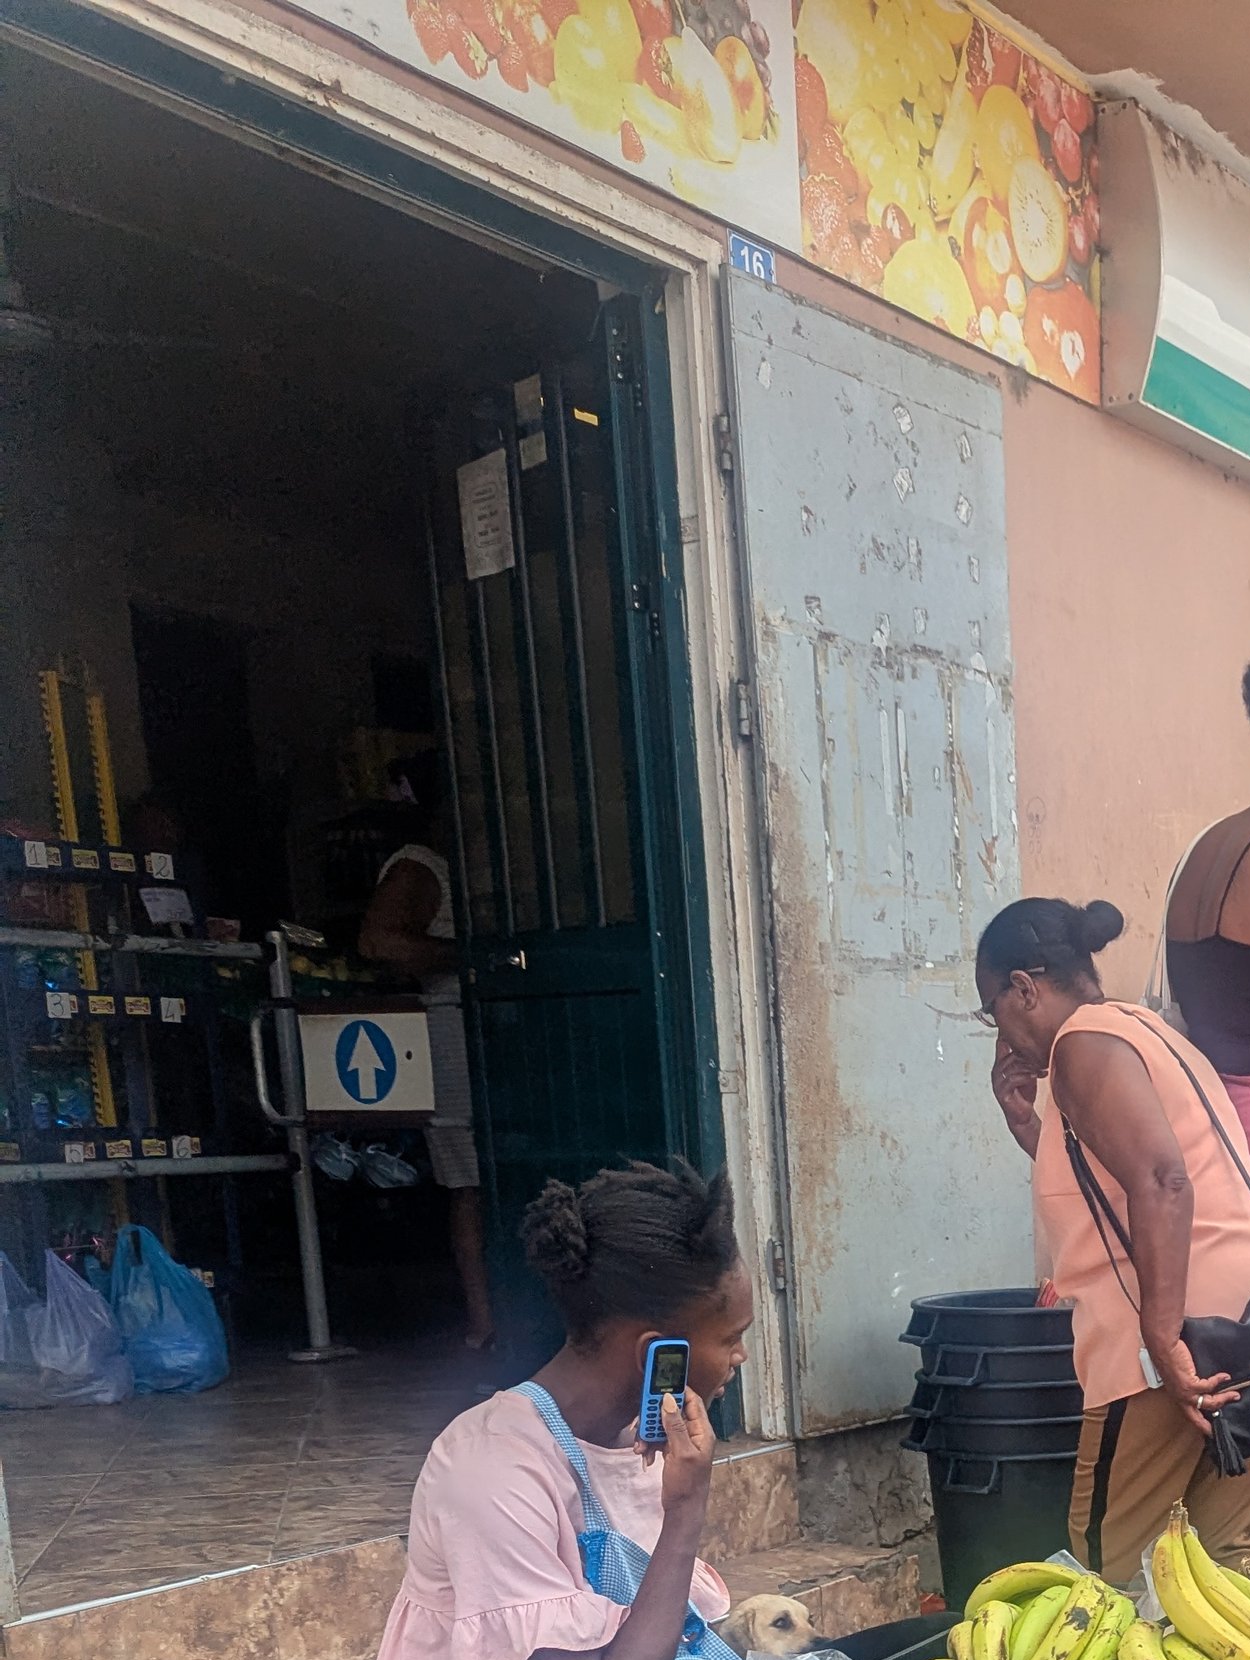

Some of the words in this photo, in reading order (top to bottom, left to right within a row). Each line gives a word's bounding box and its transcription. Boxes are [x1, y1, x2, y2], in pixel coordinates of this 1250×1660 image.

[741, 246, 765, 280] 16
[155, 855, 171, 878] 2
[51, 993, 65, 1017] 3
[164, 999, 176, 1020] 4
[176, 1137, 190, 1158] 6
